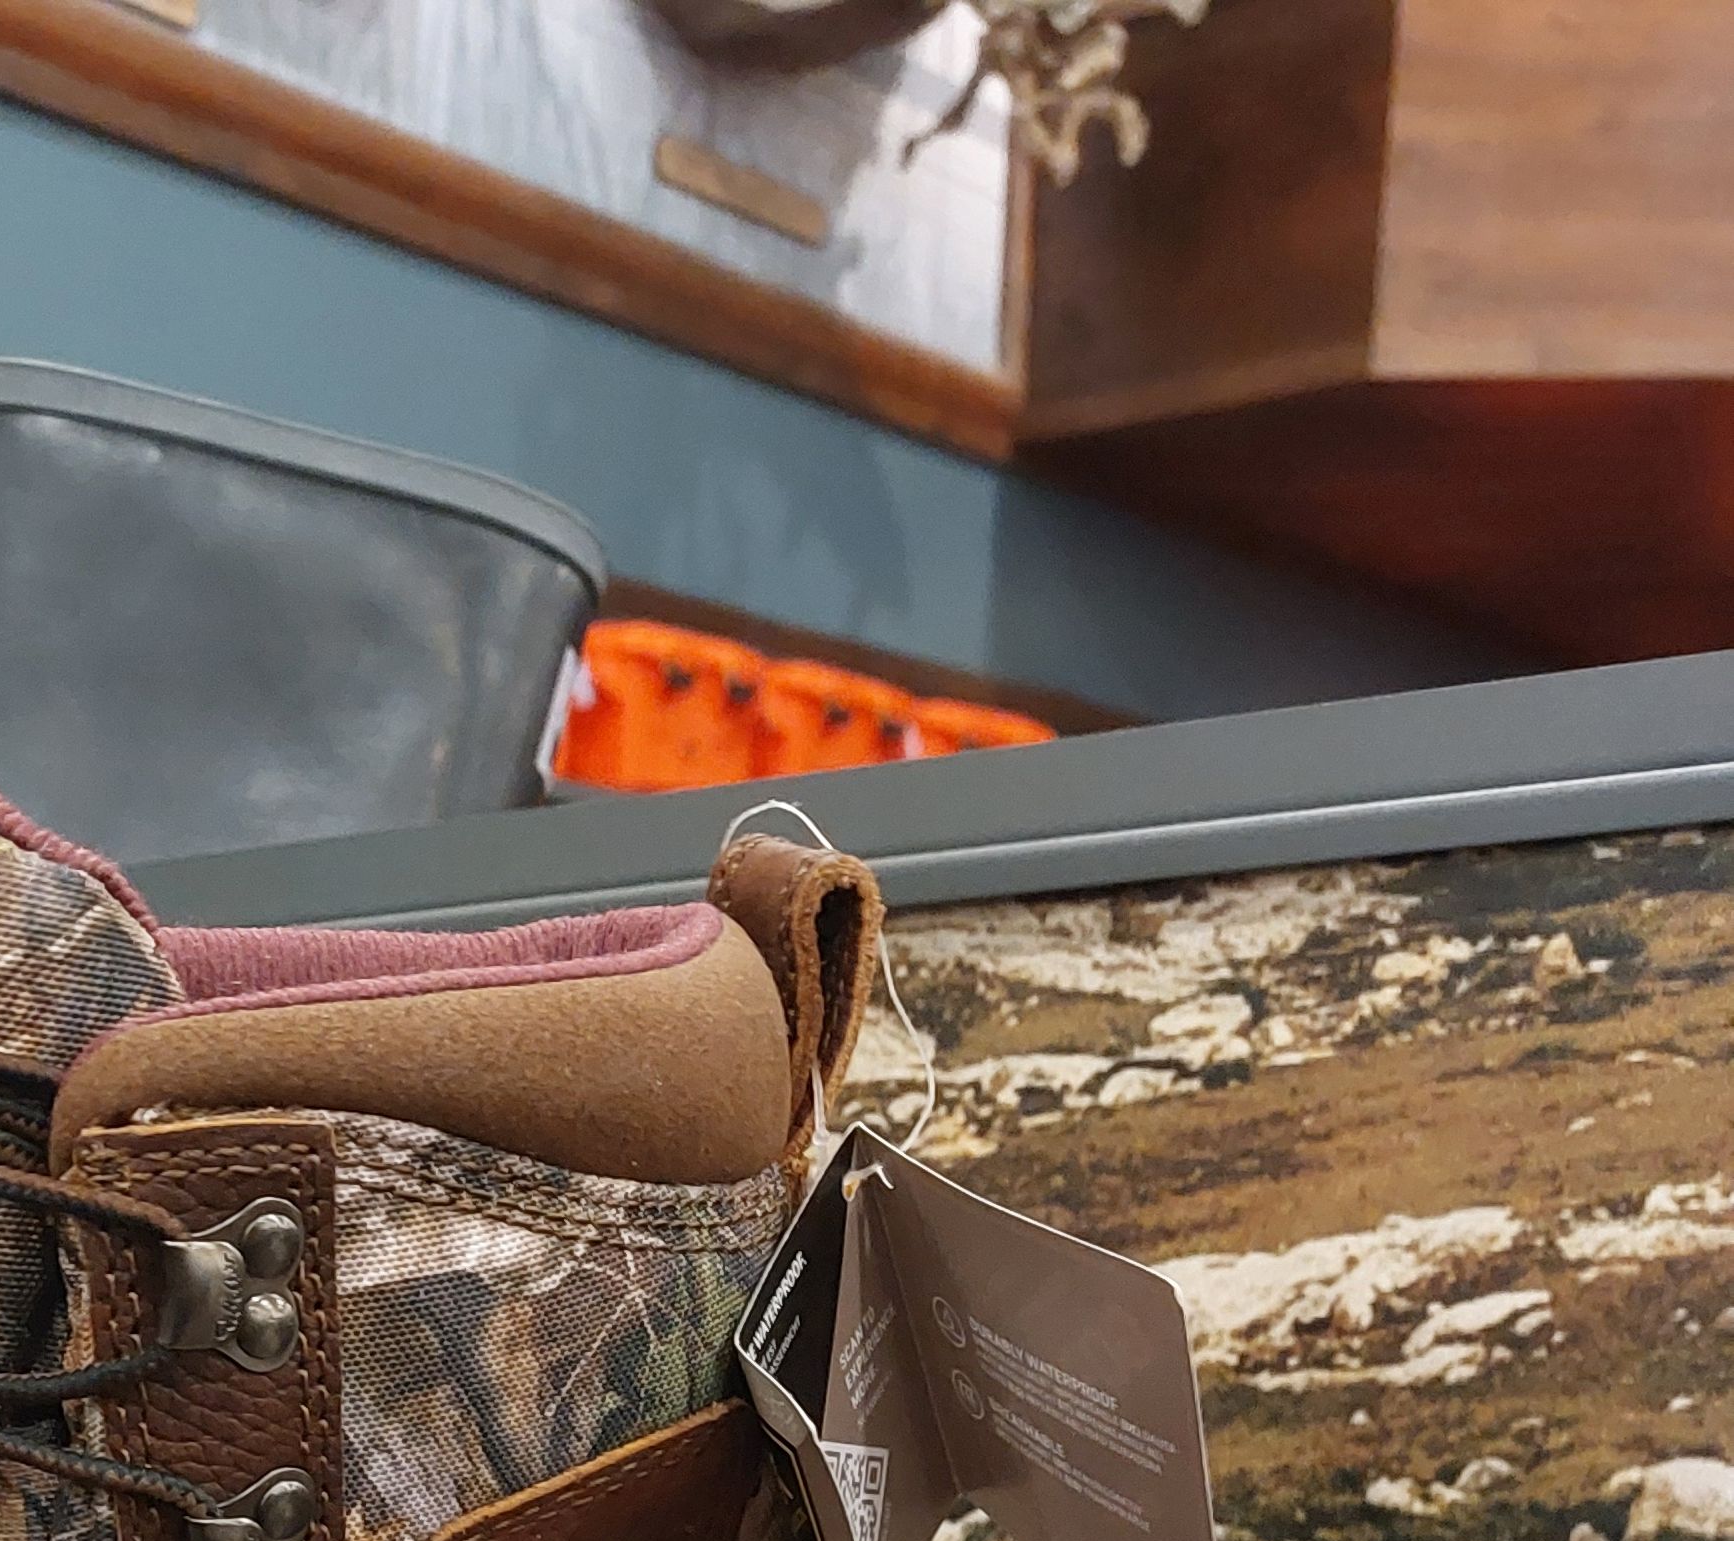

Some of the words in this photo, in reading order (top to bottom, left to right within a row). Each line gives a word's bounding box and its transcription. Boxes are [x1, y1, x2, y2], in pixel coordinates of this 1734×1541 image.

[752, 1251, 807, 1350] WATERPROOF
[839, 1323, 864, 1371] SCAN
[850, 1363, 878, 1410] MORE
